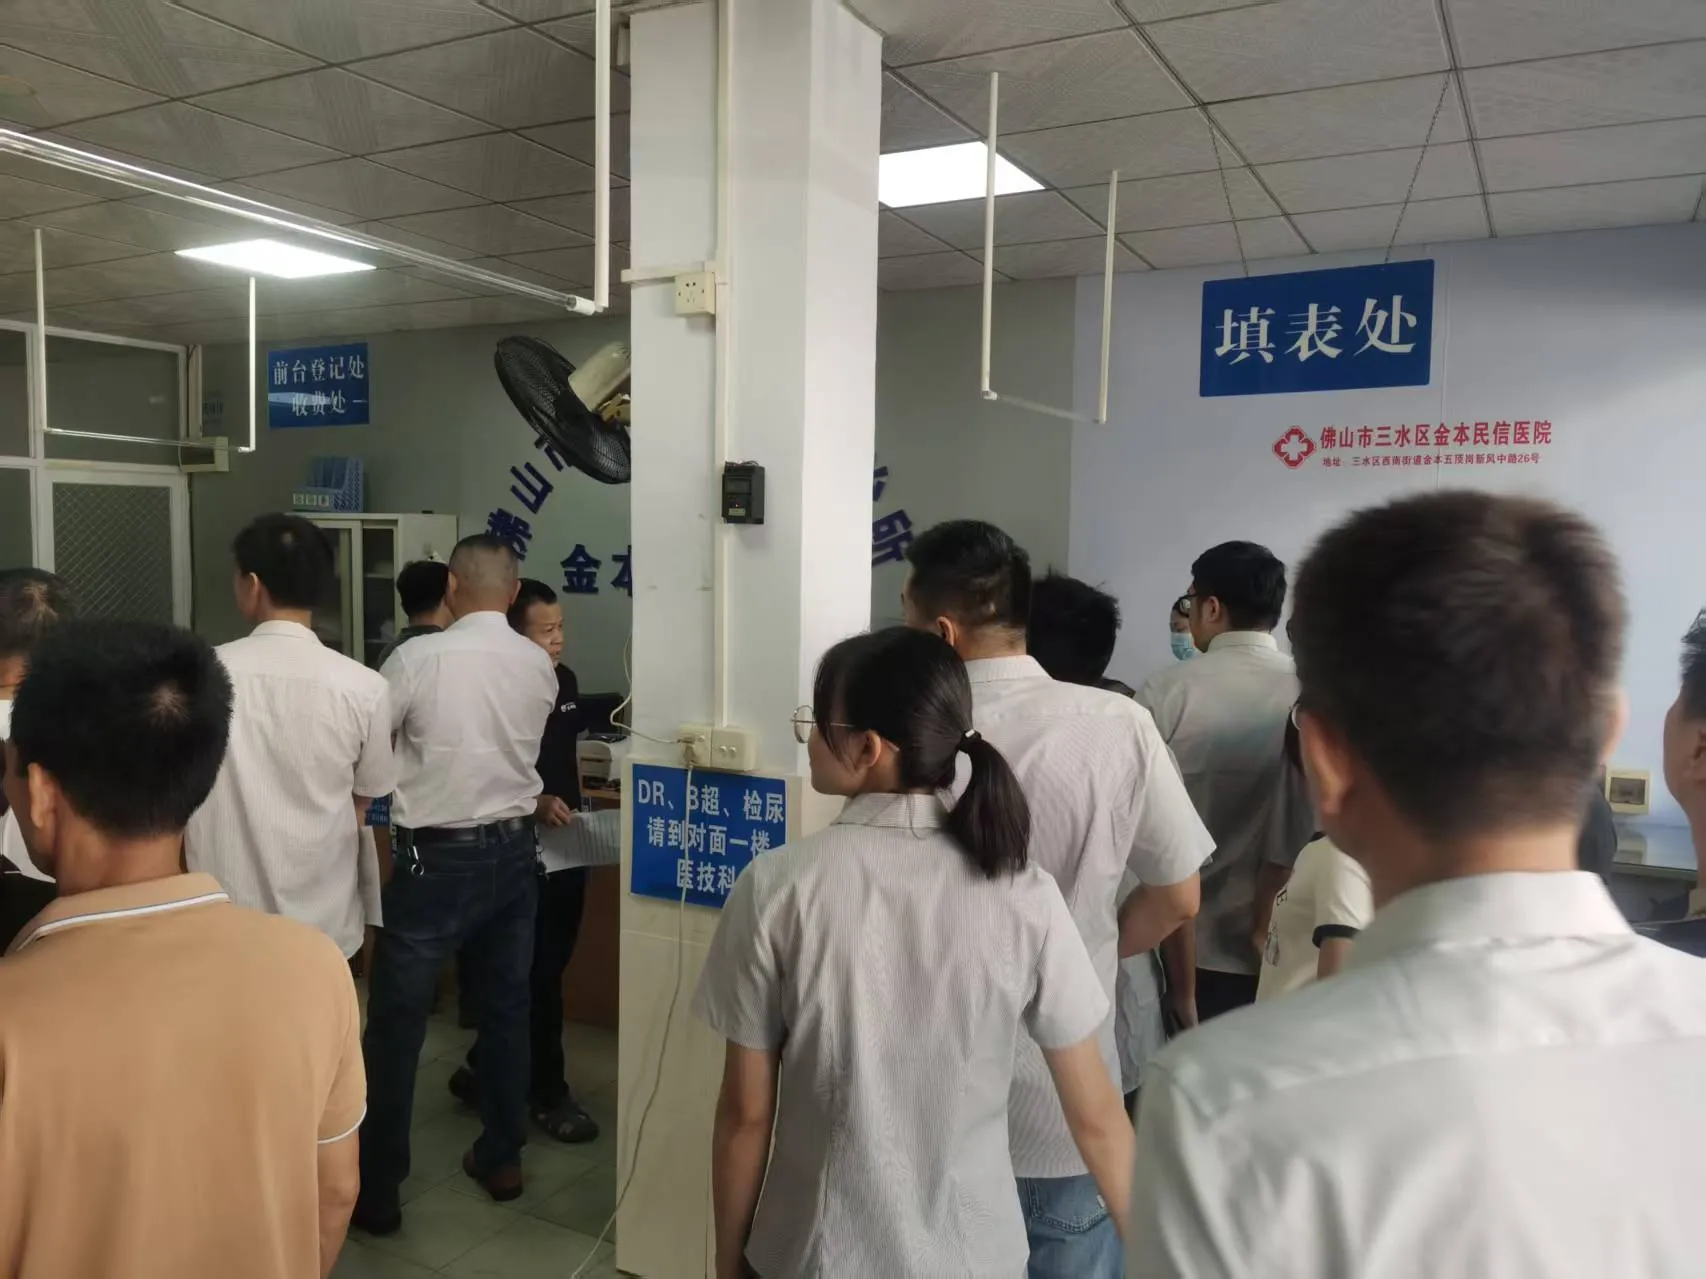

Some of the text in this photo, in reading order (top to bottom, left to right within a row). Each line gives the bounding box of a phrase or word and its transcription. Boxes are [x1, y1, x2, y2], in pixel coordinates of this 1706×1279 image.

[1215, 295, 1417, 365] 填表处
[273, 354, 365, 386] 前台登记处
[1320, 419, 1552, 449] 佛山市三水区金本民信医院
